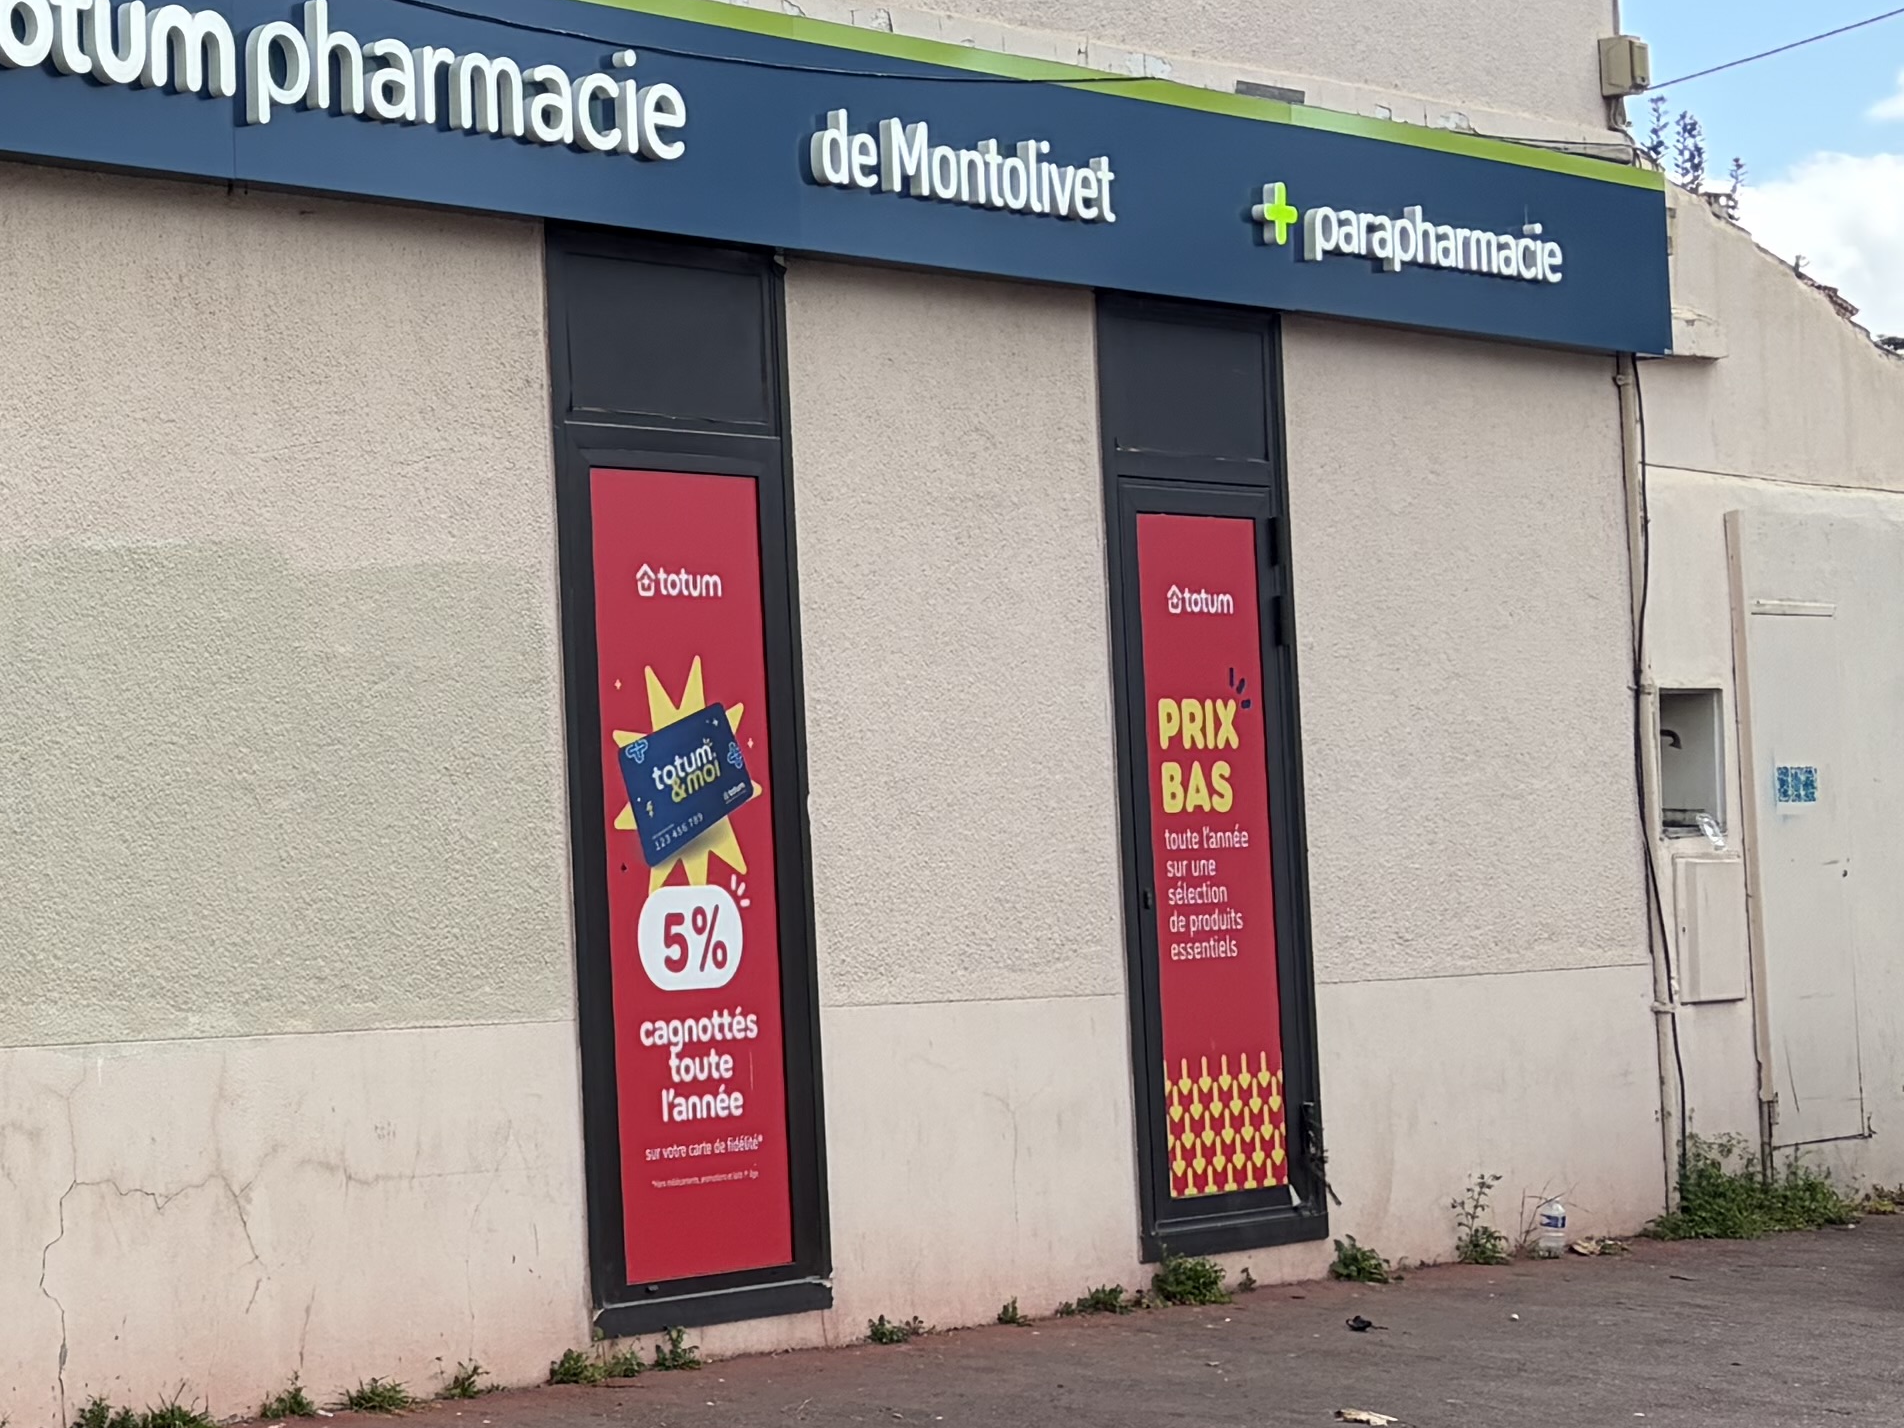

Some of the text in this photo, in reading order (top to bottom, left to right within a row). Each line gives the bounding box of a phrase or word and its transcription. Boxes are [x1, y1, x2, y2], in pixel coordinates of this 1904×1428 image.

[810, 108, 1116, 223] de Montolivet
[1304, 205, 1563, 284] parapharmacie
[658, 568, 722, 597] totum
[1183, 587, 1234, 614] totum
[1158, 698, 1239, 749] PRIX
[652, 743, 713, 791] totum
[1161, 760, 1233, 813] BAS
[1165, 824, 1248, 850] toute l'année
[1166, 859, 1216, 877] sur une
[1168, 880, 1227, 905] sélection
[663, 904, 727, 973] 5%
[1169, 907, 1243, 937] de produits
[1170, 935, 1238, 960] essentiels
[640, 1006, 758, 1049] cagnottés
[669, 1047, 733, 1083] toute
[661, 1084, 743, 1122] l'année
[645, 1147, 660, 1160] sur
[662, 1144, 686, 1159] votre
[688, 1141, 712, 1157] carte
[714, 1138, 725, 1154] de
